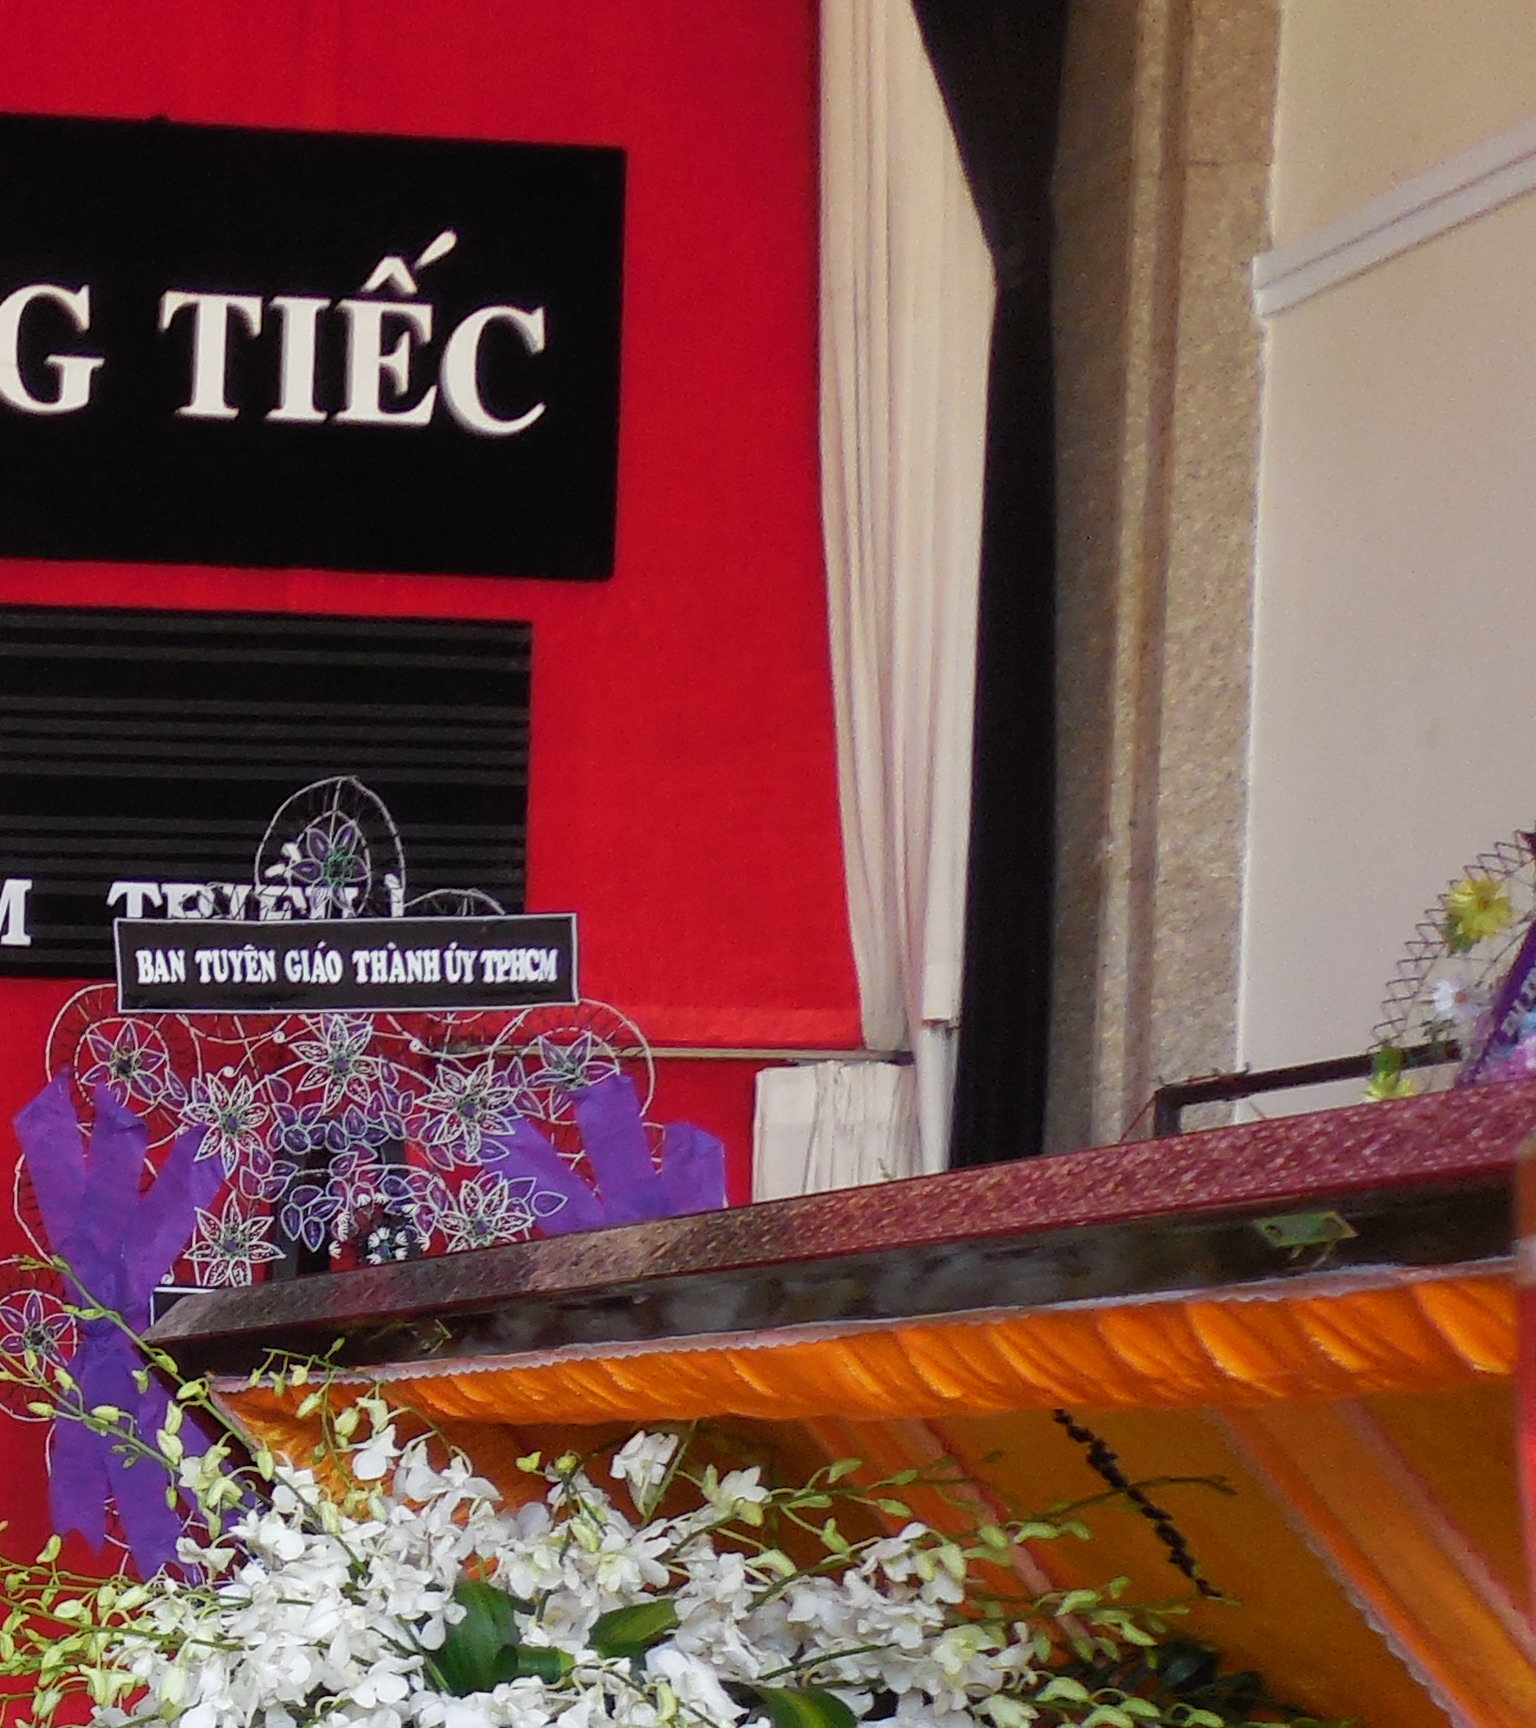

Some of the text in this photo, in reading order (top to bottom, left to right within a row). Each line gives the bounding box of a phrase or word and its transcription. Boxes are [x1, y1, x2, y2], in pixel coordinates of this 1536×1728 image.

[159, 230, 546, 435] TIẾC
[135, 949, 186, 984] BAN
[195, 944, 276, 984] TUYÊN
[284, 940, 343, 984] GIÁO
[352, 941, 441, 984] THÀNH
[480, 948, 558, 983] TPHCM
